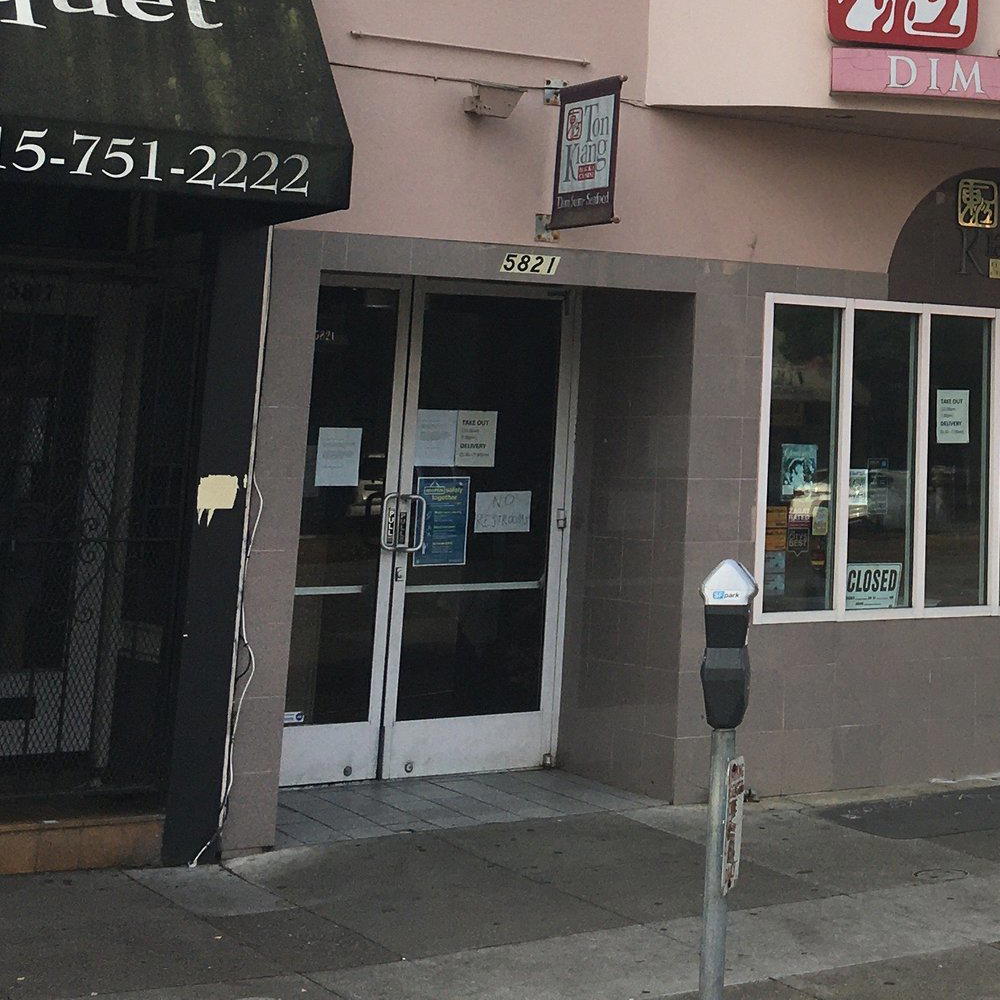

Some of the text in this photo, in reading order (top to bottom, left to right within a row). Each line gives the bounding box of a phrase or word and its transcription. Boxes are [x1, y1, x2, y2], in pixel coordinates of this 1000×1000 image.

[886, 55, 985, 94] DIM
[585, 102, 609, 142] Ton
[563, 139, 608, 183] Kiang
[503, 254, 556, 274] 5821
[462, 419, 476, 427] TAKE
[492, 493, 515, 508] NO
[846, 568, 898, 593] CLOSED
